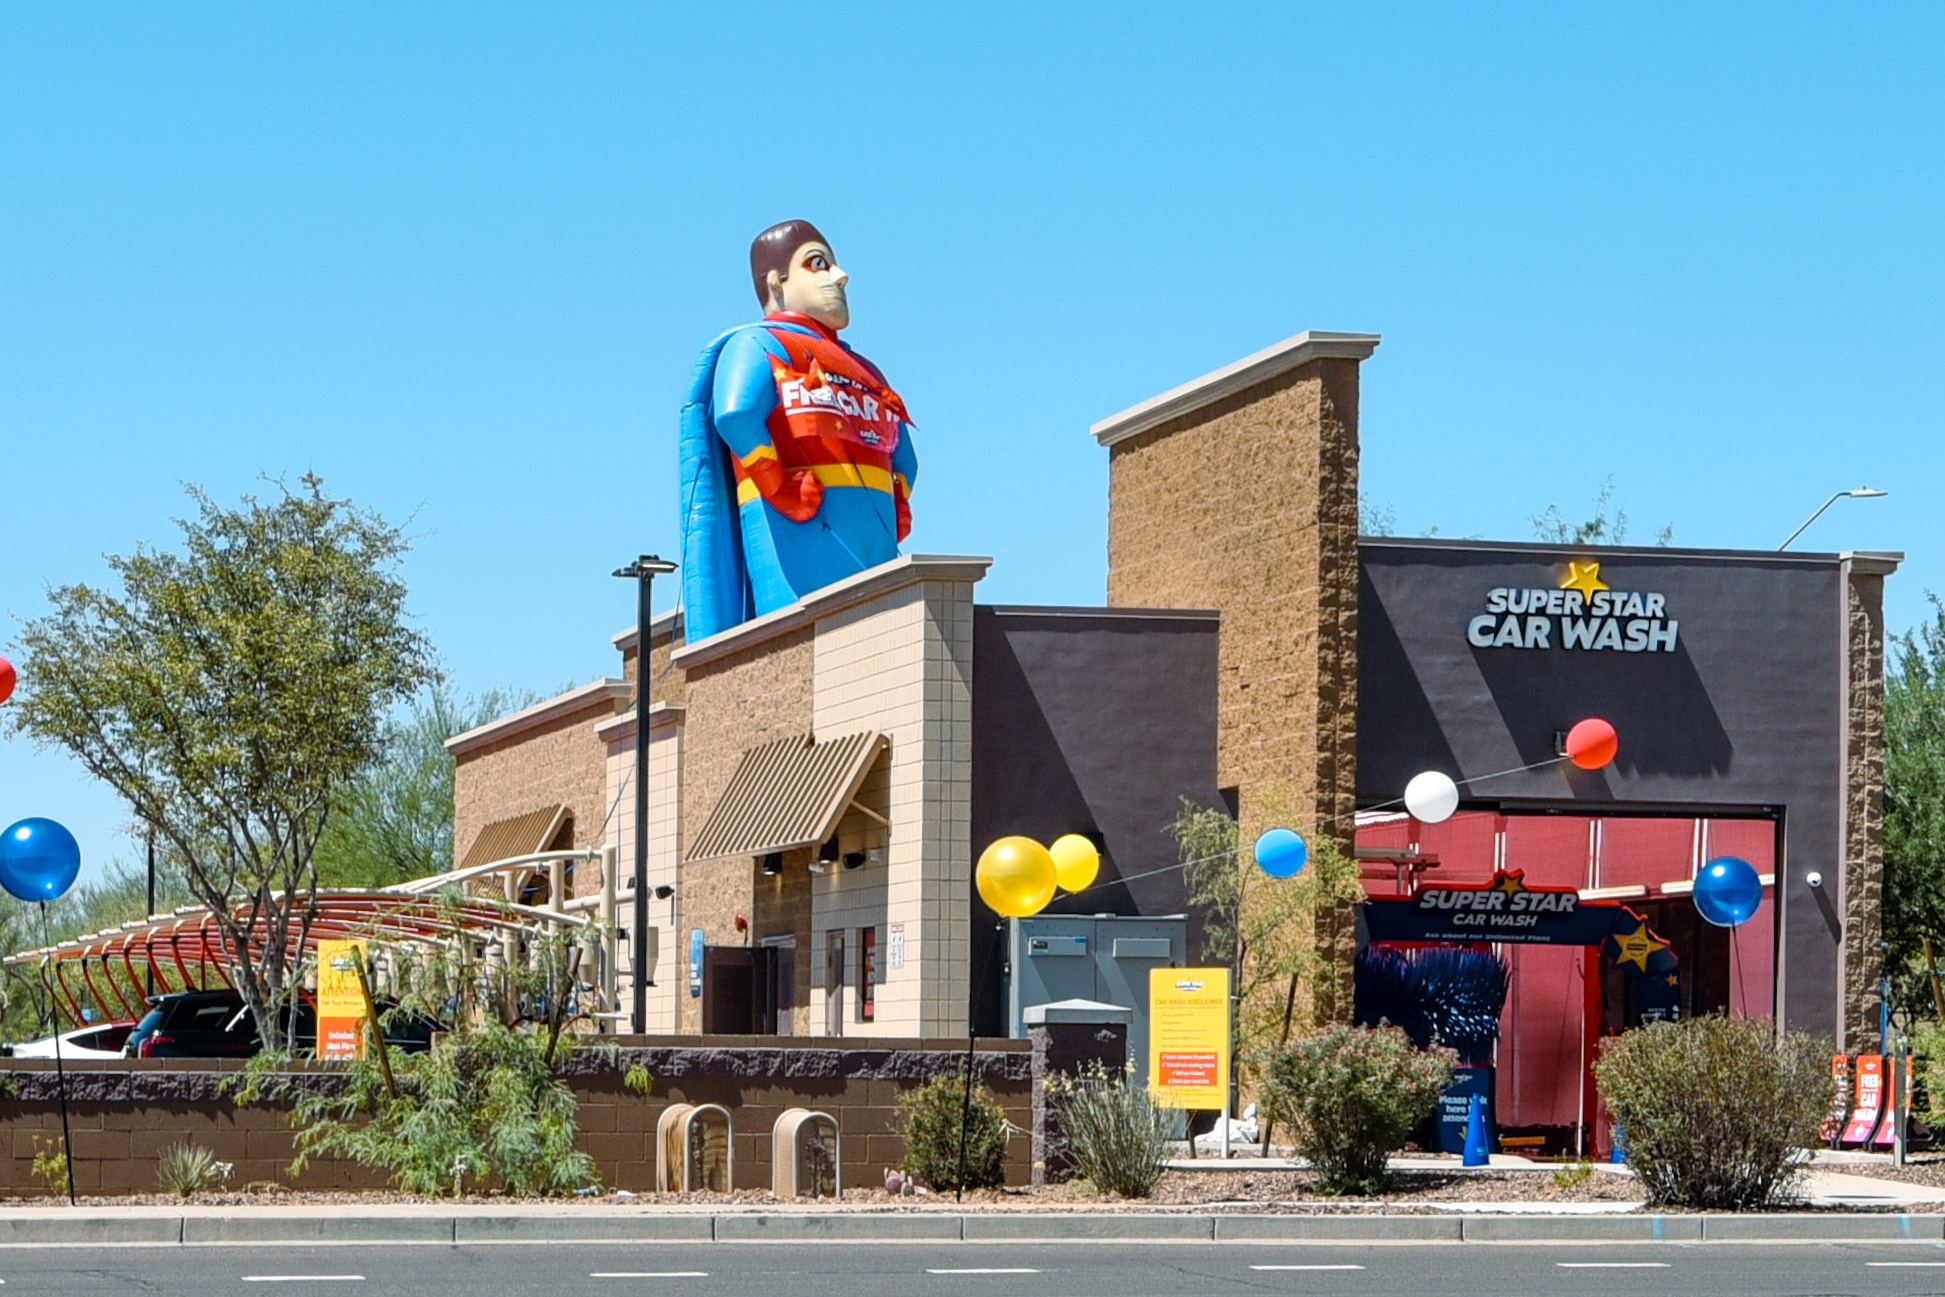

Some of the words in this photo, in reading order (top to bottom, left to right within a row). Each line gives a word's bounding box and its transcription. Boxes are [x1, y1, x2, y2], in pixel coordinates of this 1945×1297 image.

[1487, 588, 1583, 615] SUPER
[1591, 592, 1665, 618] STAR
[1467, 614, 1551, 648] CAR
[1561, 616, 1679, 652] WASH
[1419, 890, 1505, 911] SUPER
[1509, 890, 1578, 913] STAR
[1452, 913, 1486, 926] CAR
[1490, 914, 1538, 927] WASH
[1485, 933, 1526, 942] Unlimited
[1438, 1095, 1468, 1105] Please
[1445, 1105, 1467, 1114] here
